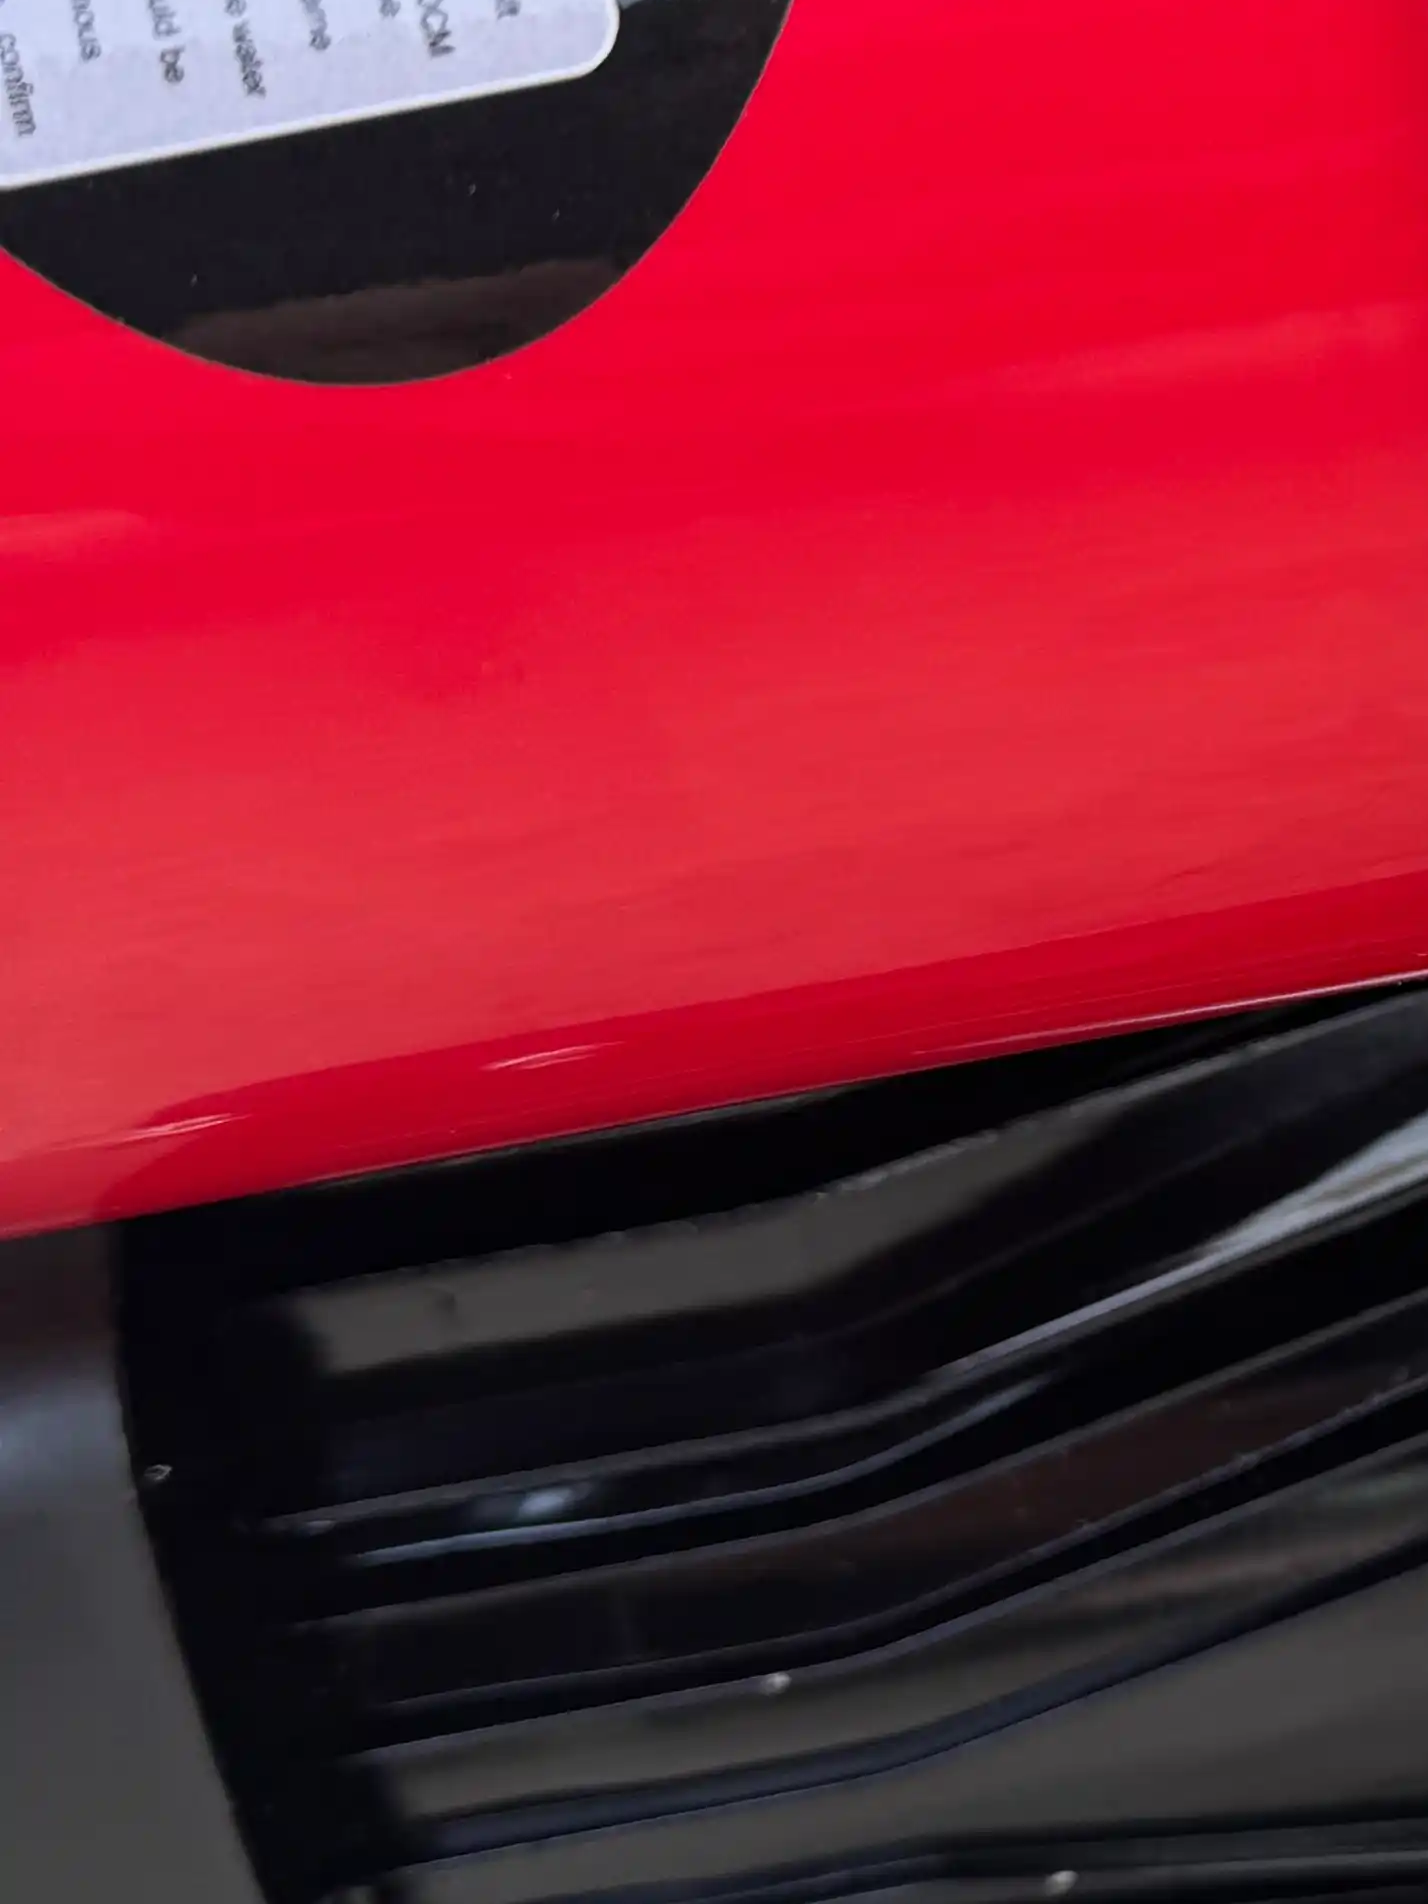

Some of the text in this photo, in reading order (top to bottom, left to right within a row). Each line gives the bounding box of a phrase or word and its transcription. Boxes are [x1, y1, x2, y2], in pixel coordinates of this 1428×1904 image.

[0, 33, 37, 138] confirm
[159, 47, 185, 84] be
[233, 21, 266, 97] water
